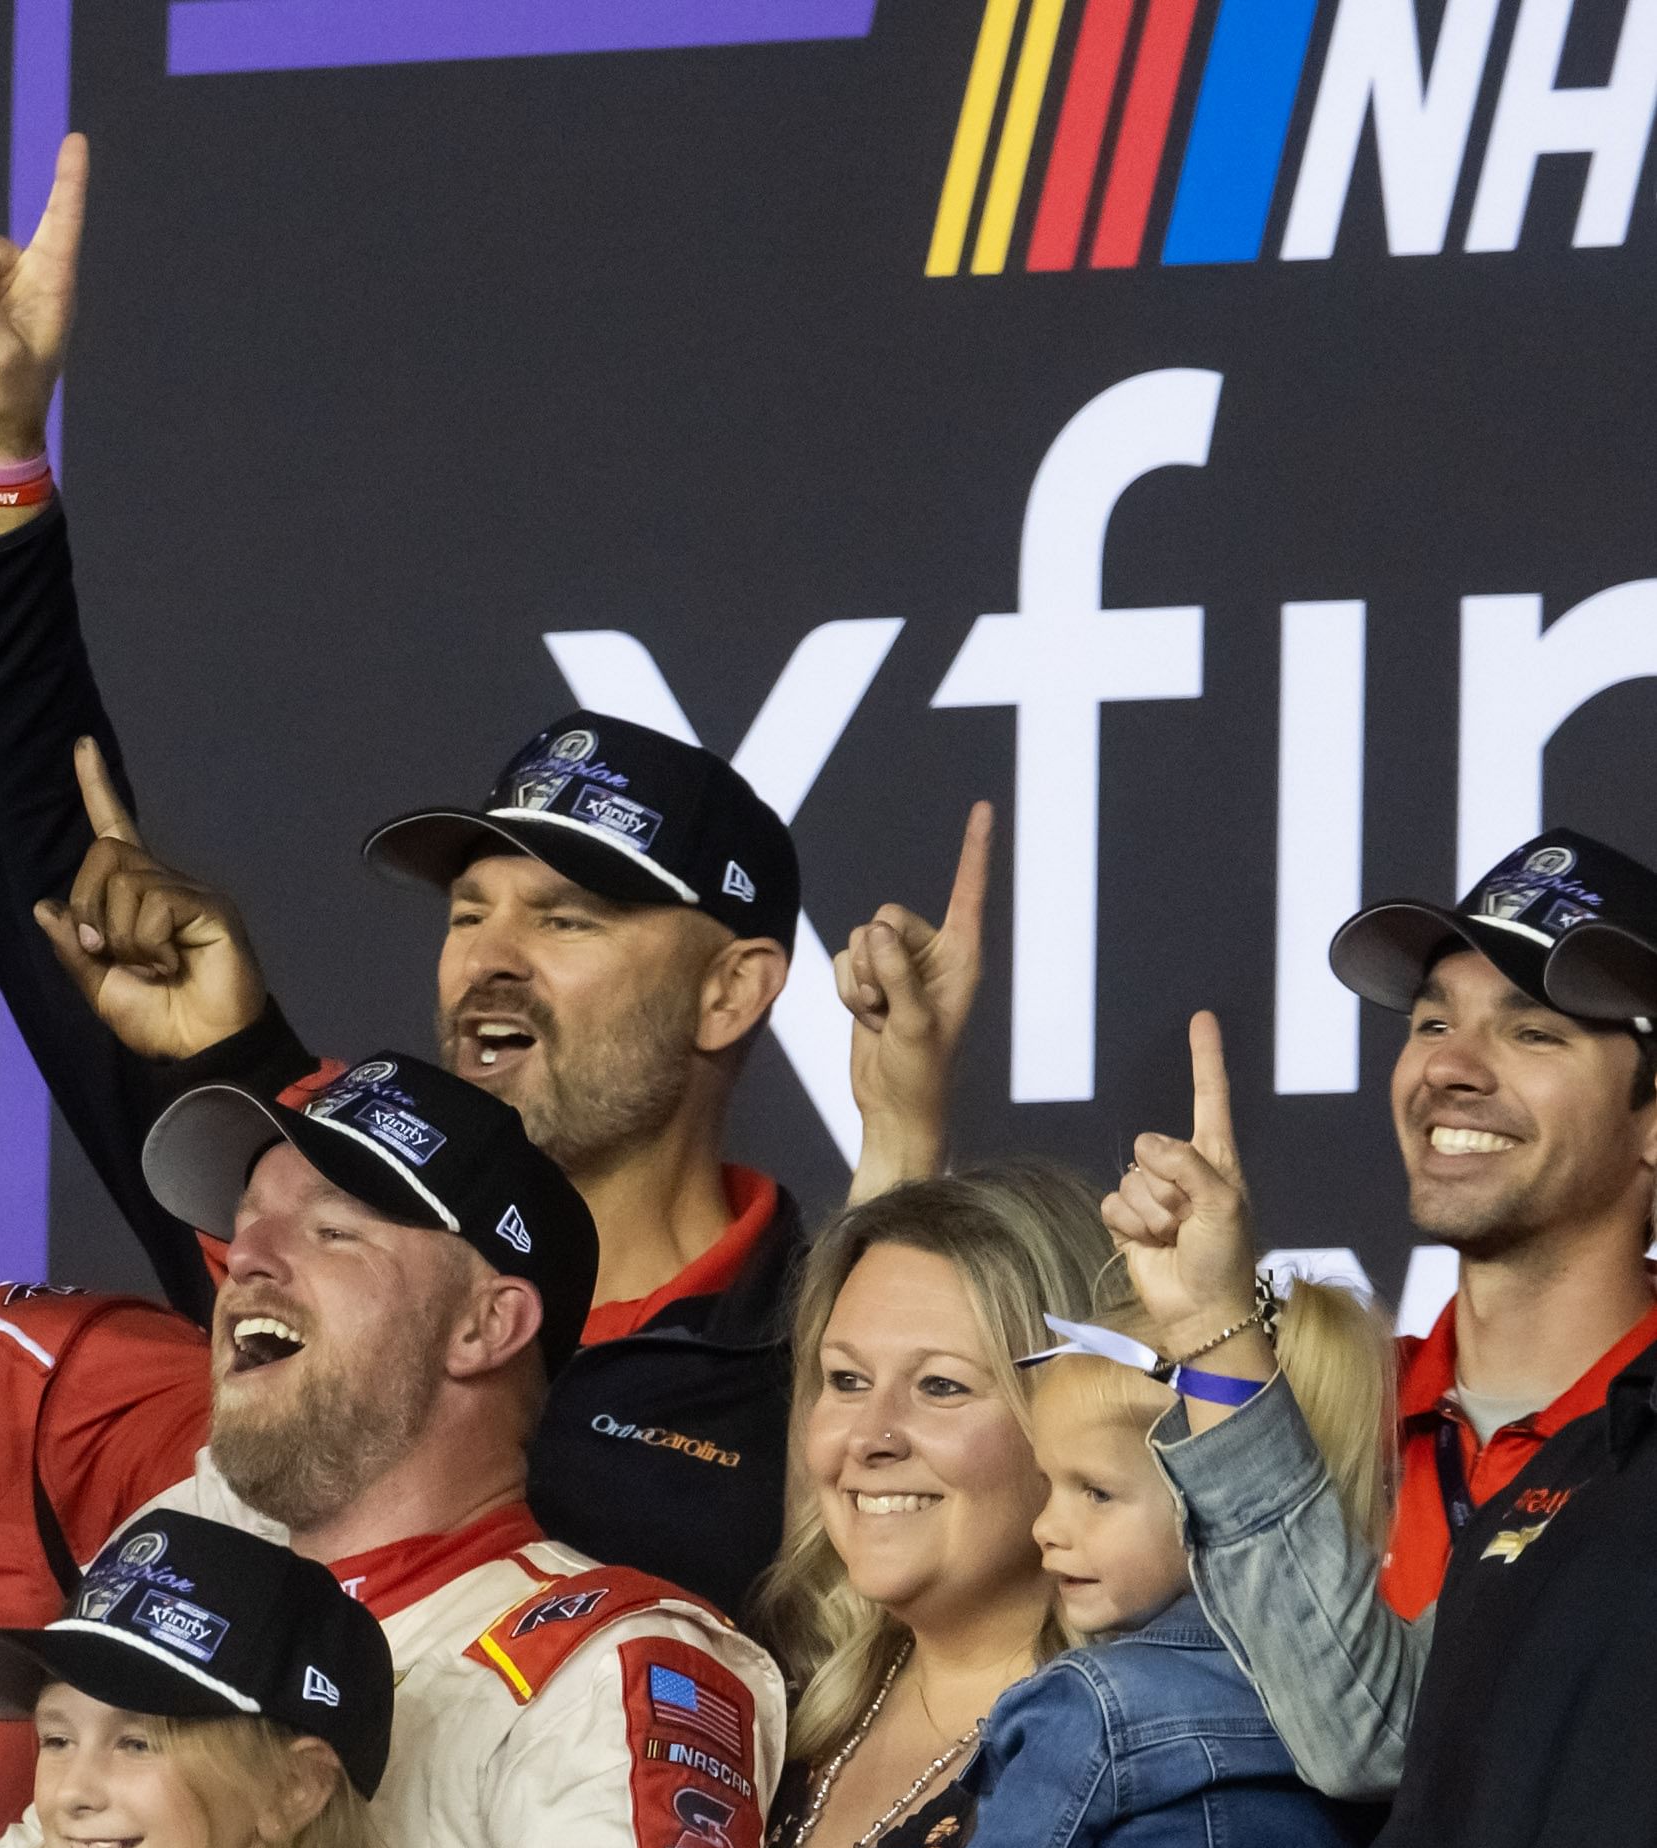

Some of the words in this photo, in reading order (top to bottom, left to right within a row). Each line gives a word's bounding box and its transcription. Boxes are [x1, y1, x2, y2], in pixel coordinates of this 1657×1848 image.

[587, 799, 647, 833] xfinity
[370, 1109, 430, 1146] xfinity
[591, 1414, 741, 1467] OrthoCarolina
[148, 1605, 211, 1640] xfinity
[678, 1743, 752, 1798] NASCAR
